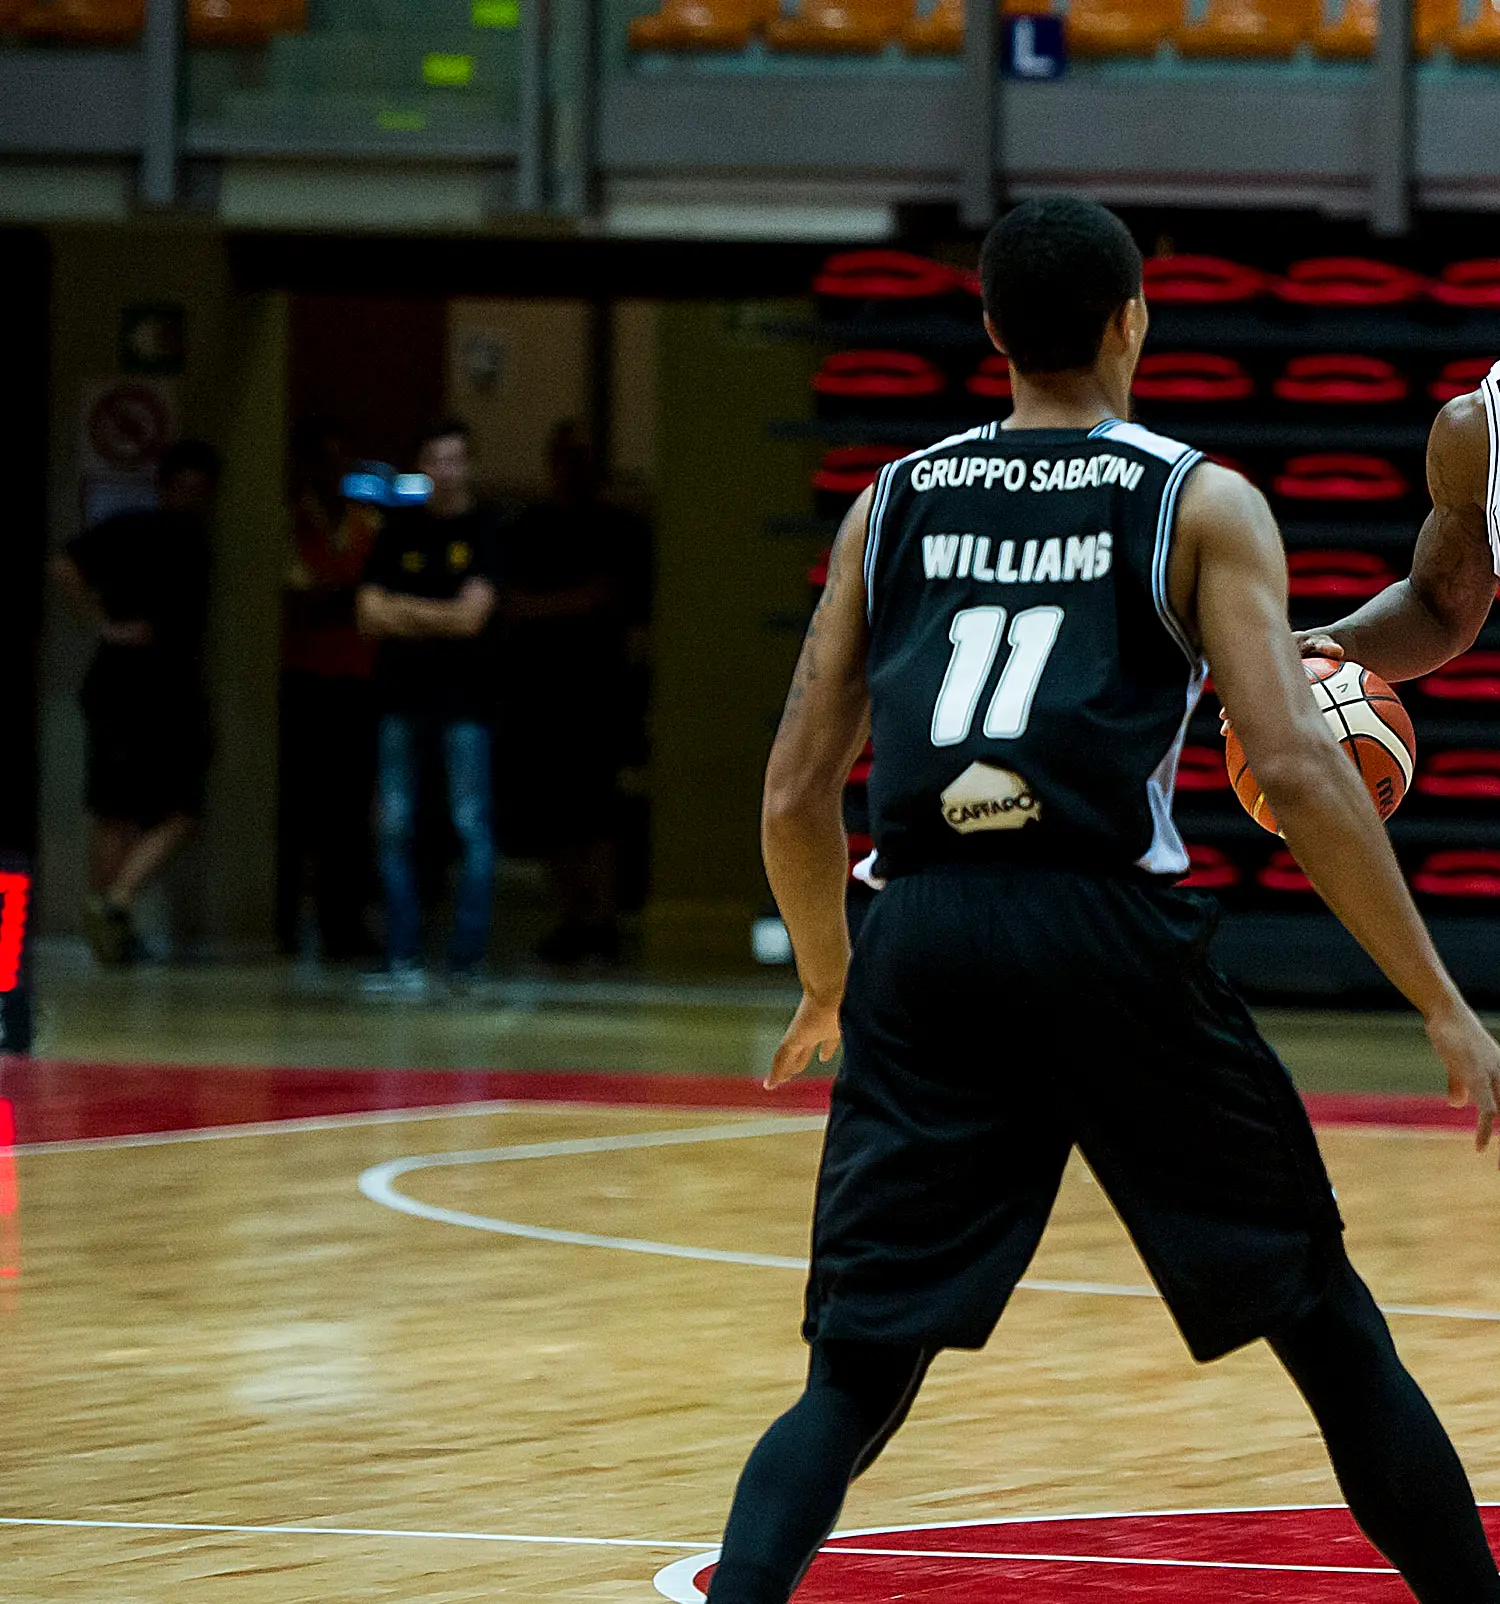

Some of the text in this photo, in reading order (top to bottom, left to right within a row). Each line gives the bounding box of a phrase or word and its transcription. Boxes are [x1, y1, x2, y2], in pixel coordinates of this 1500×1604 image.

[1014, 15, 1057, 77] L
[910, 456, 1027, 492] GRUPPO
[921, 530, 1114, 584] WILLIAMS
[930, 604, 1065, 748] 11
